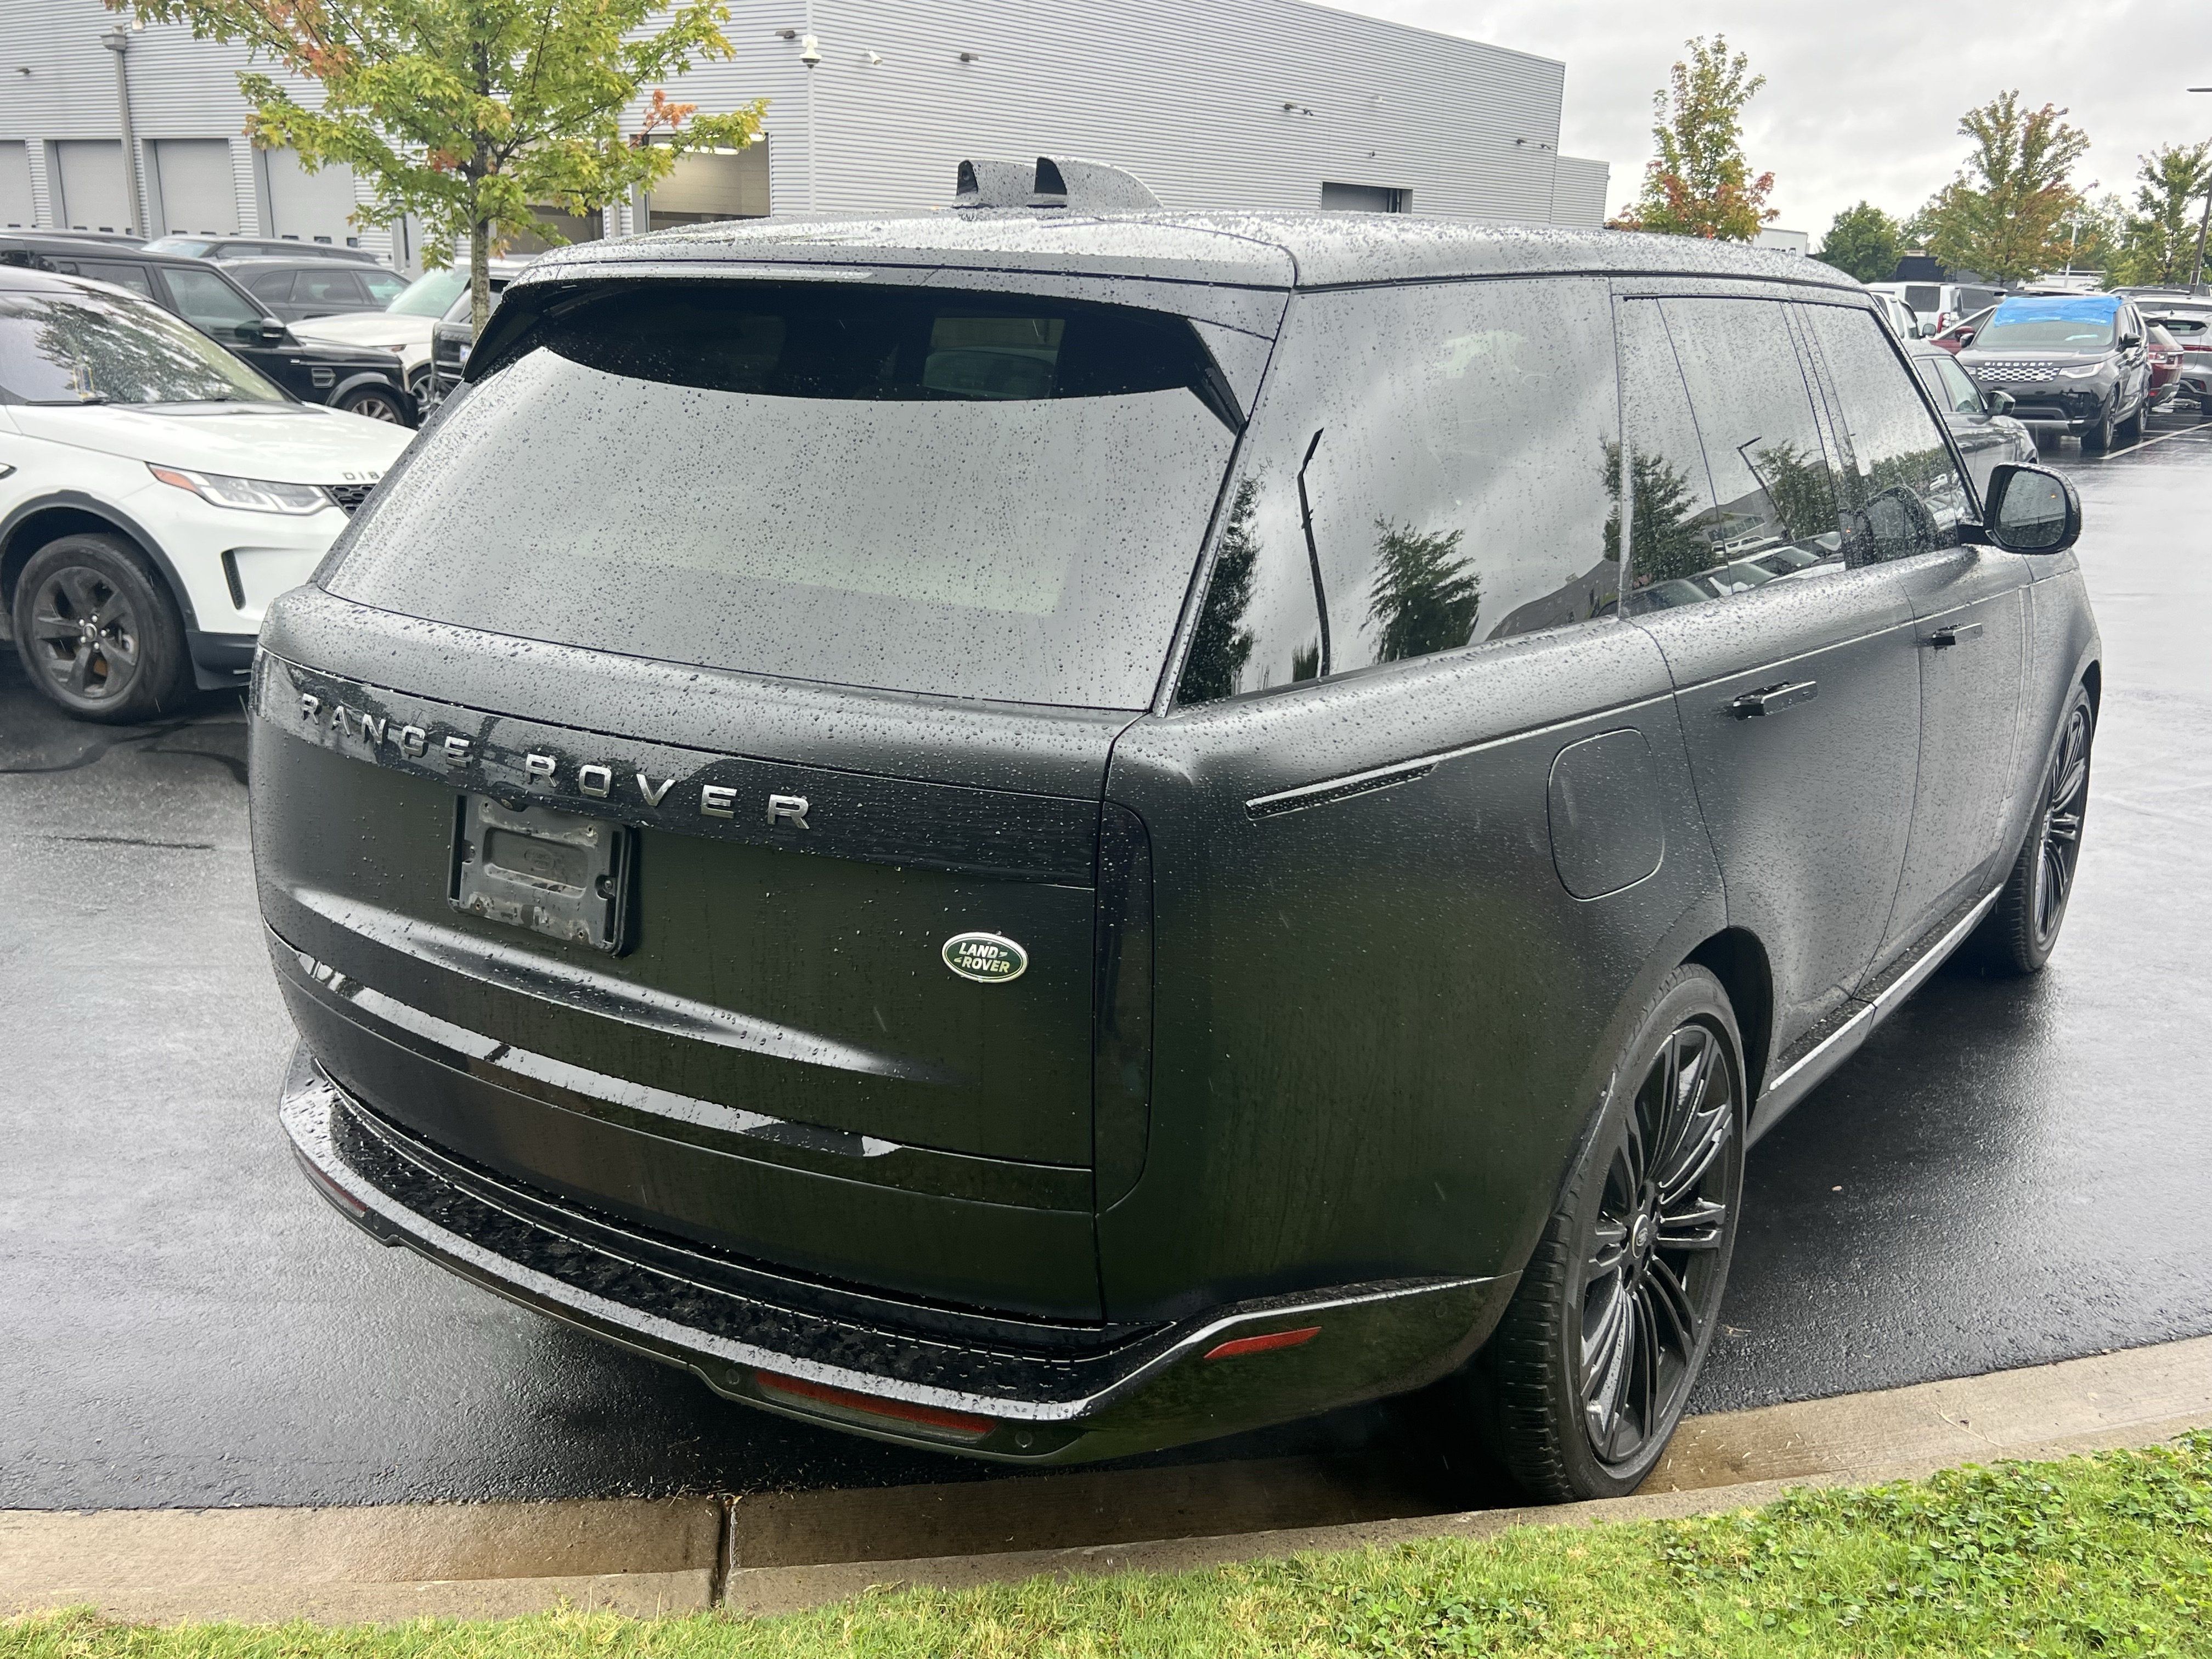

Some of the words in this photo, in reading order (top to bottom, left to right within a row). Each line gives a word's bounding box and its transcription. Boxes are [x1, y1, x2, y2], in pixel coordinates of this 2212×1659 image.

[300, 692, 473, 768] RANGE
[525, 753, 811, 830] ROVER
[959, 942, 998, 958] LAND
[962, 956, 1010, 973] ROVER
